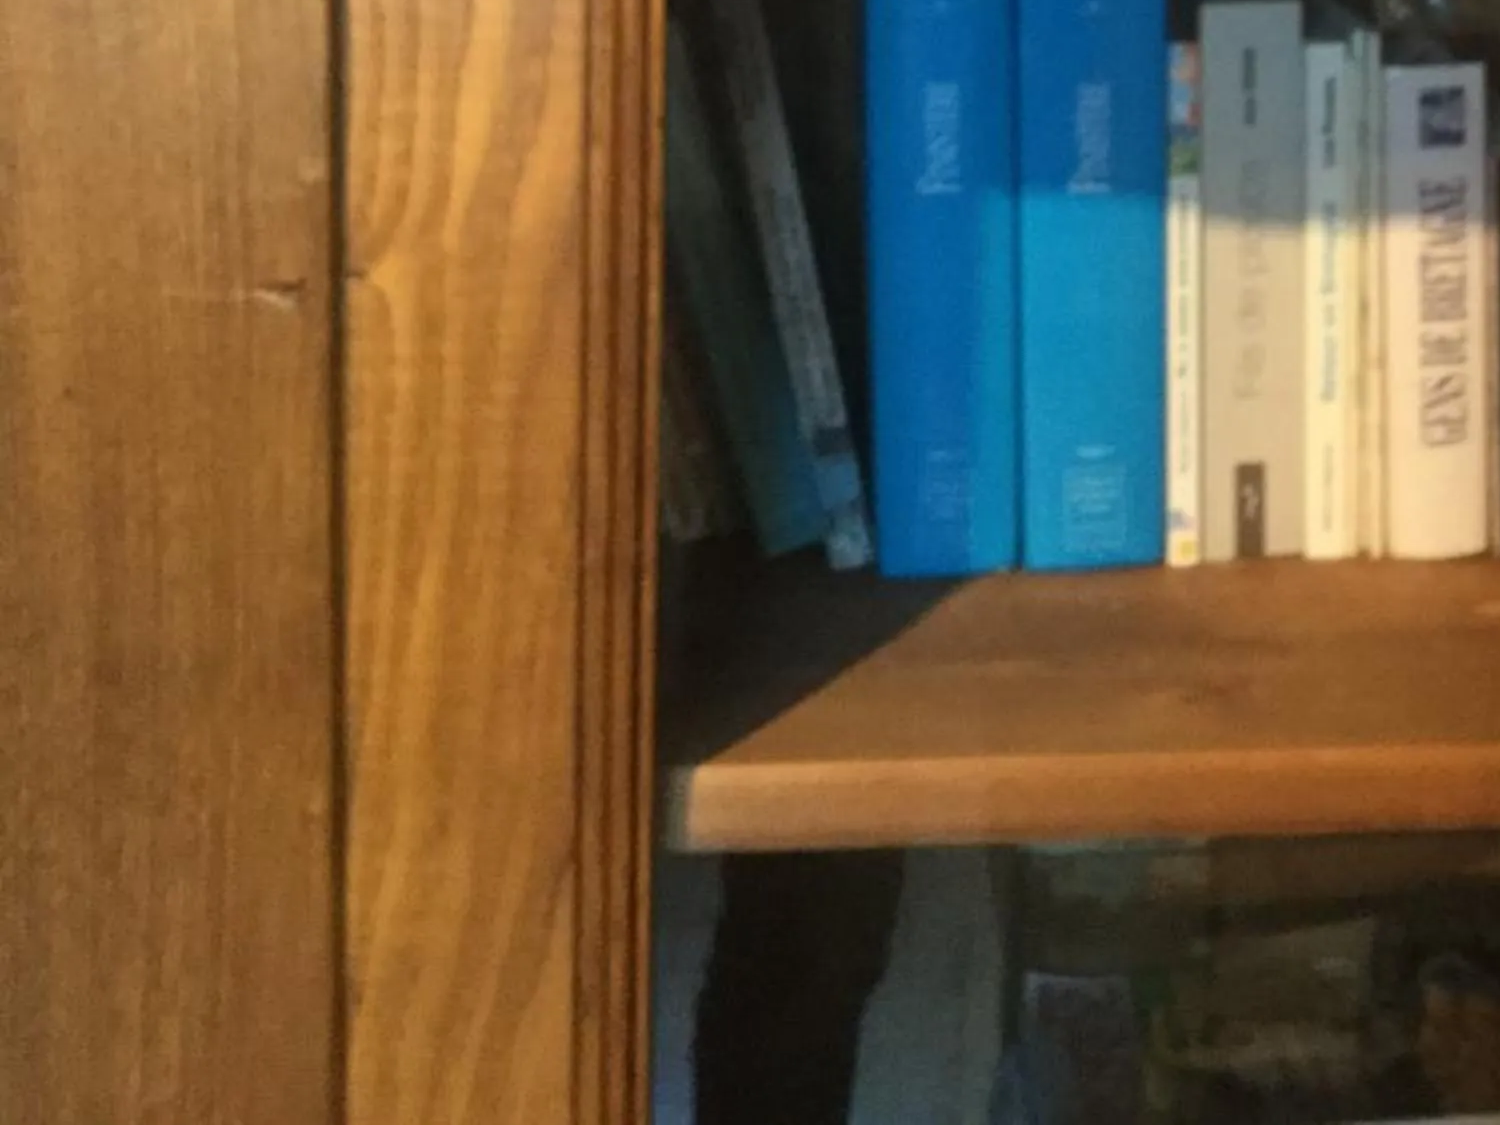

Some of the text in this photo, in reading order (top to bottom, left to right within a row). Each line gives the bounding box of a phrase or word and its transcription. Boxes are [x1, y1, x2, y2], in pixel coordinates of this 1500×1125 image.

[1414, 175, 1471, 449] GENS DE BRETAGNE
